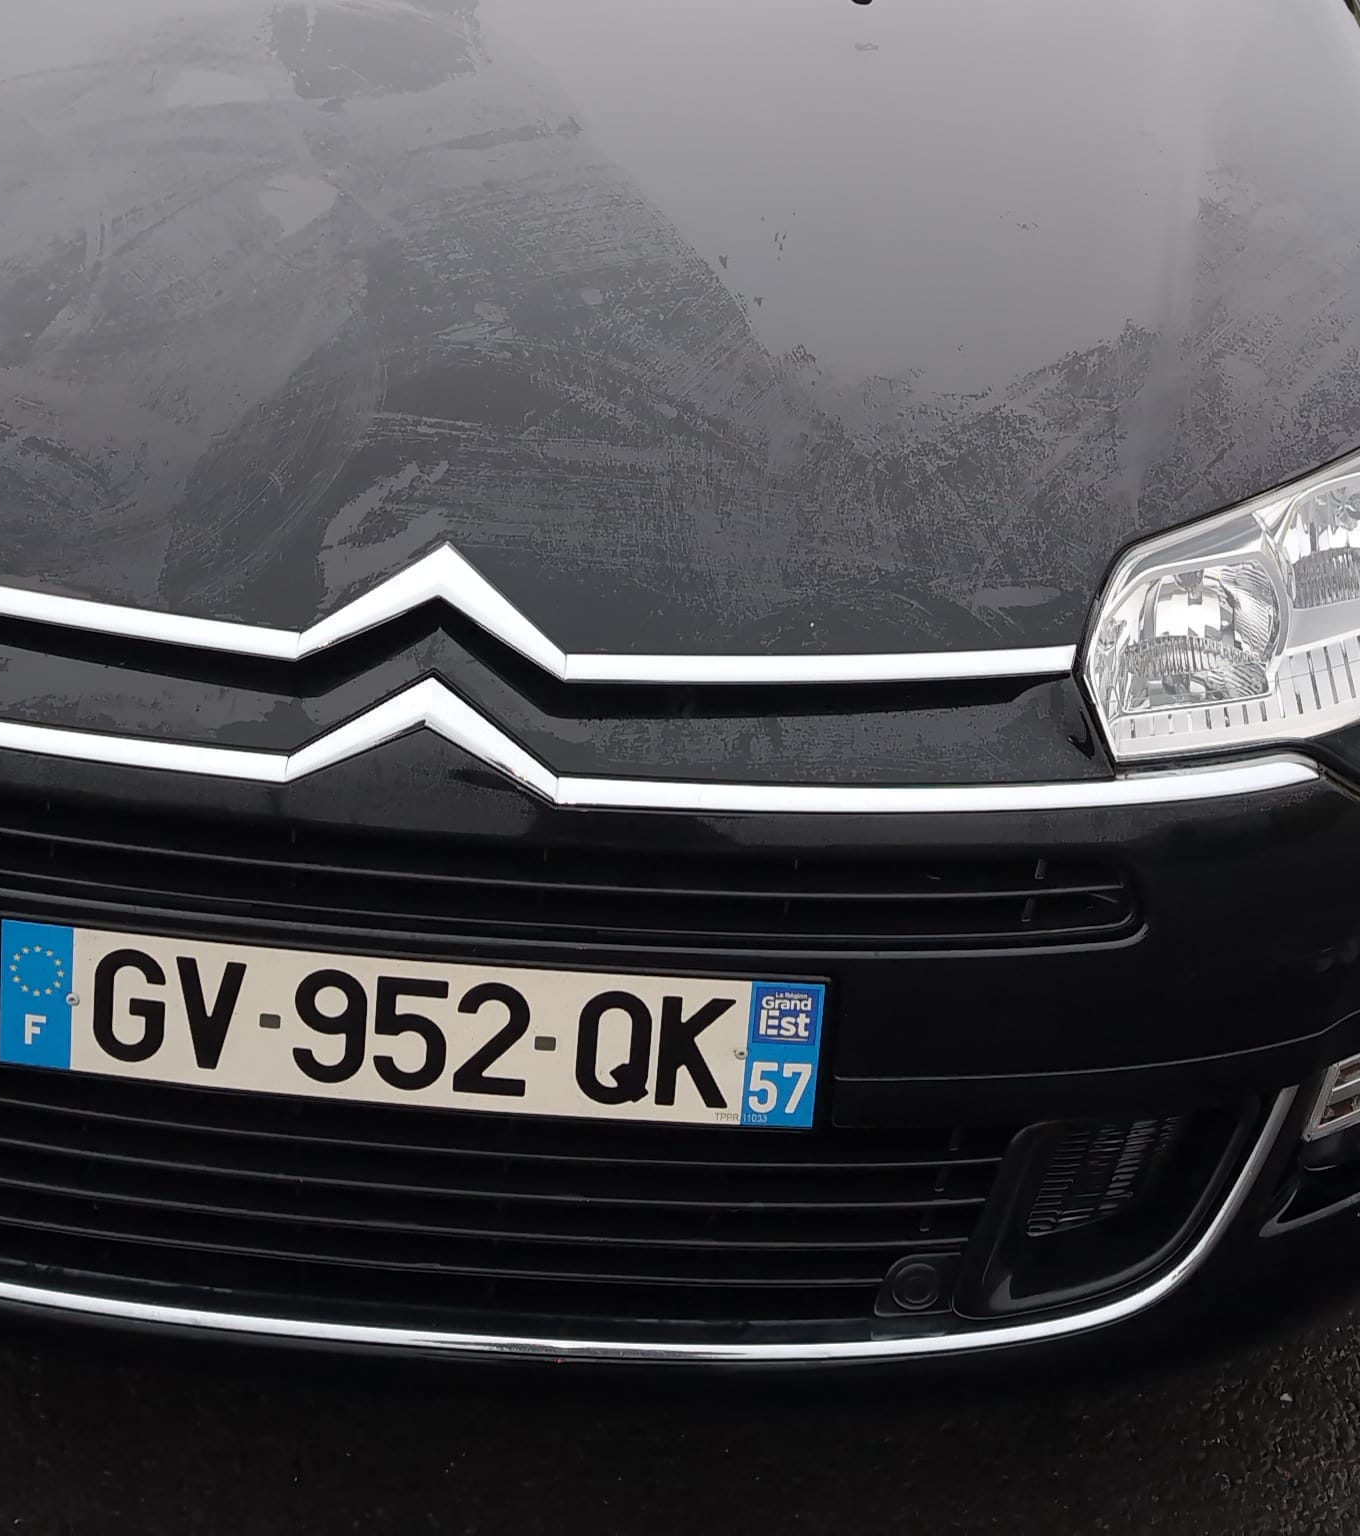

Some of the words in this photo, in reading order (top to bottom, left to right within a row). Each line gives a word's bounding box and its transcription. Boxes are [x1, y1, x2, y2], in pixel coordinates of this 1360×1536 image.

[762, 995, 812, 1011] Grand
[24, 1013, 47, 1045] F
[93, 949, 737, 1109] GV-952-QK
[759, 1009, 810, 1037] Est
[748, 1061, 812, 1114] 57
